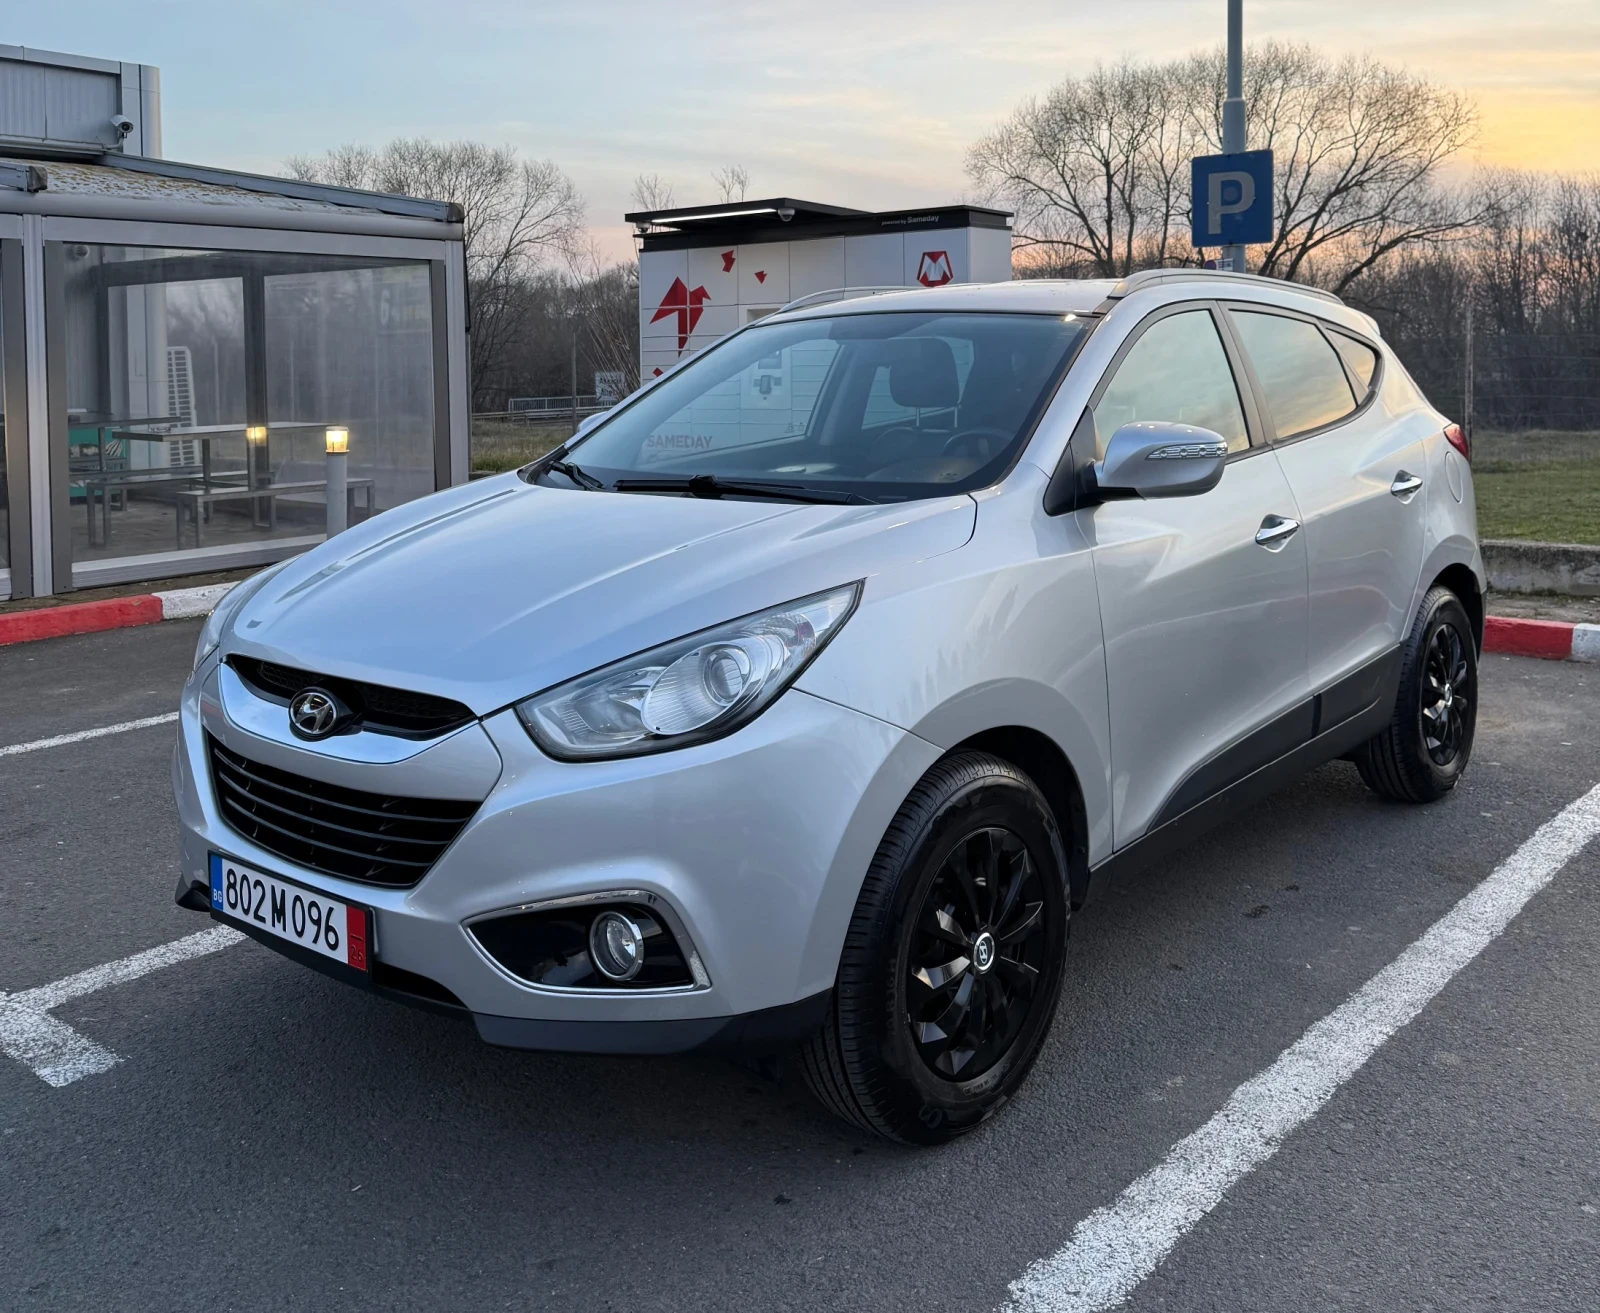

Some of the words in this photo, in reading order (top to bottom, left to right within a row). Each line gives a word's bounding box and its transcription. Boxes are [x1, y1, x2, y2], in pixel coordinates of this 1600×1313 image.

[1208, 171, 1255, 234] P
[907, 215, 940, 224] Sameday
[647, 435, 713, 449] SAMEDAY
[213, 888, 223, 903] BG
[226, 868, 339, 951] 802M096
